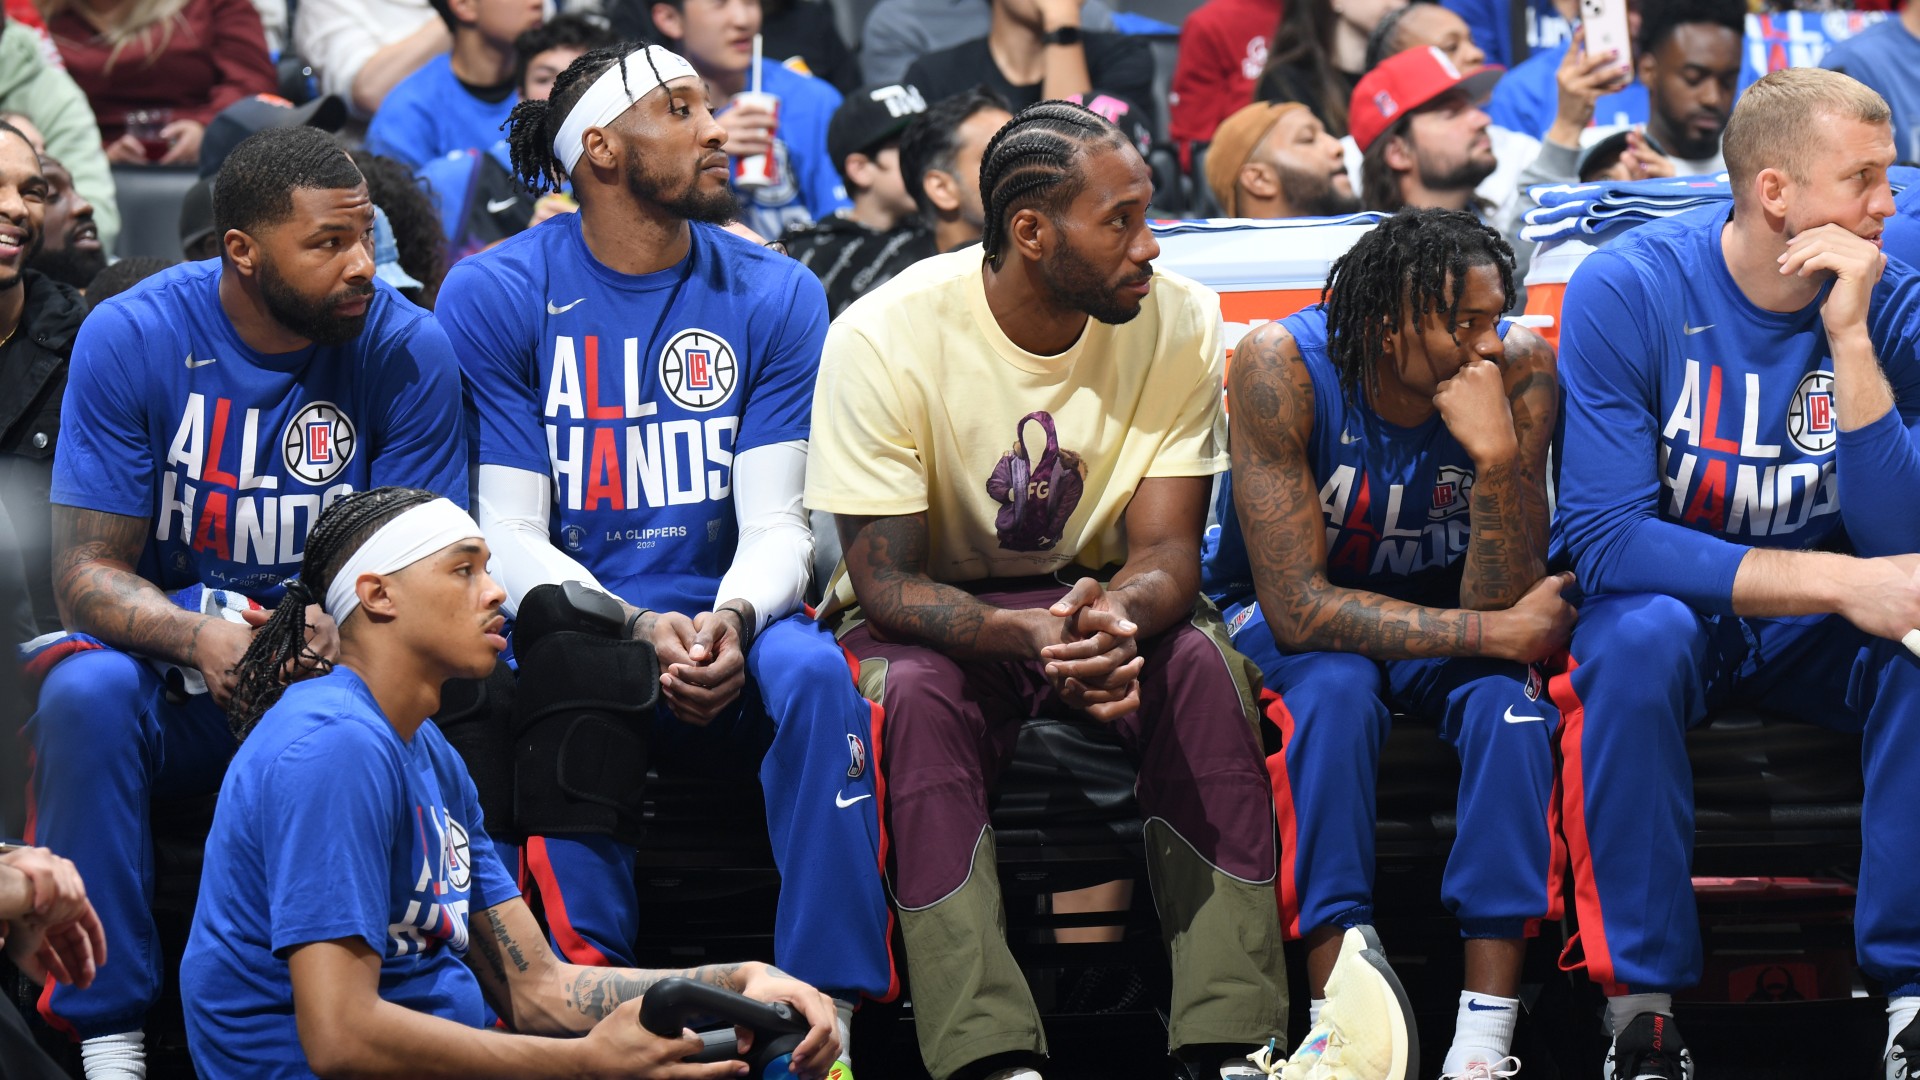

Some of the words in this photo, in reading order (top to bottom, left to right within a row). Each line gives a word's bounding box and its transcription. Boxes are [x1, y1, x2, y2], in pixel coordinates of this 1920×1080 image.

[545, 335, 657, 420] ALL
[1663, 358, 1781, 458] ALL
[167, 392, 278, 490] ALL
[545, 415, 740, 511] HANDS
[155, 470, 353, 565] HAND
[606, 531, 622, 542] LA
[625, 526, 687, 540] CLIPPERS
[637, 541, 656, 549] 2023
[1318, 464, 1422, 542] ALL
